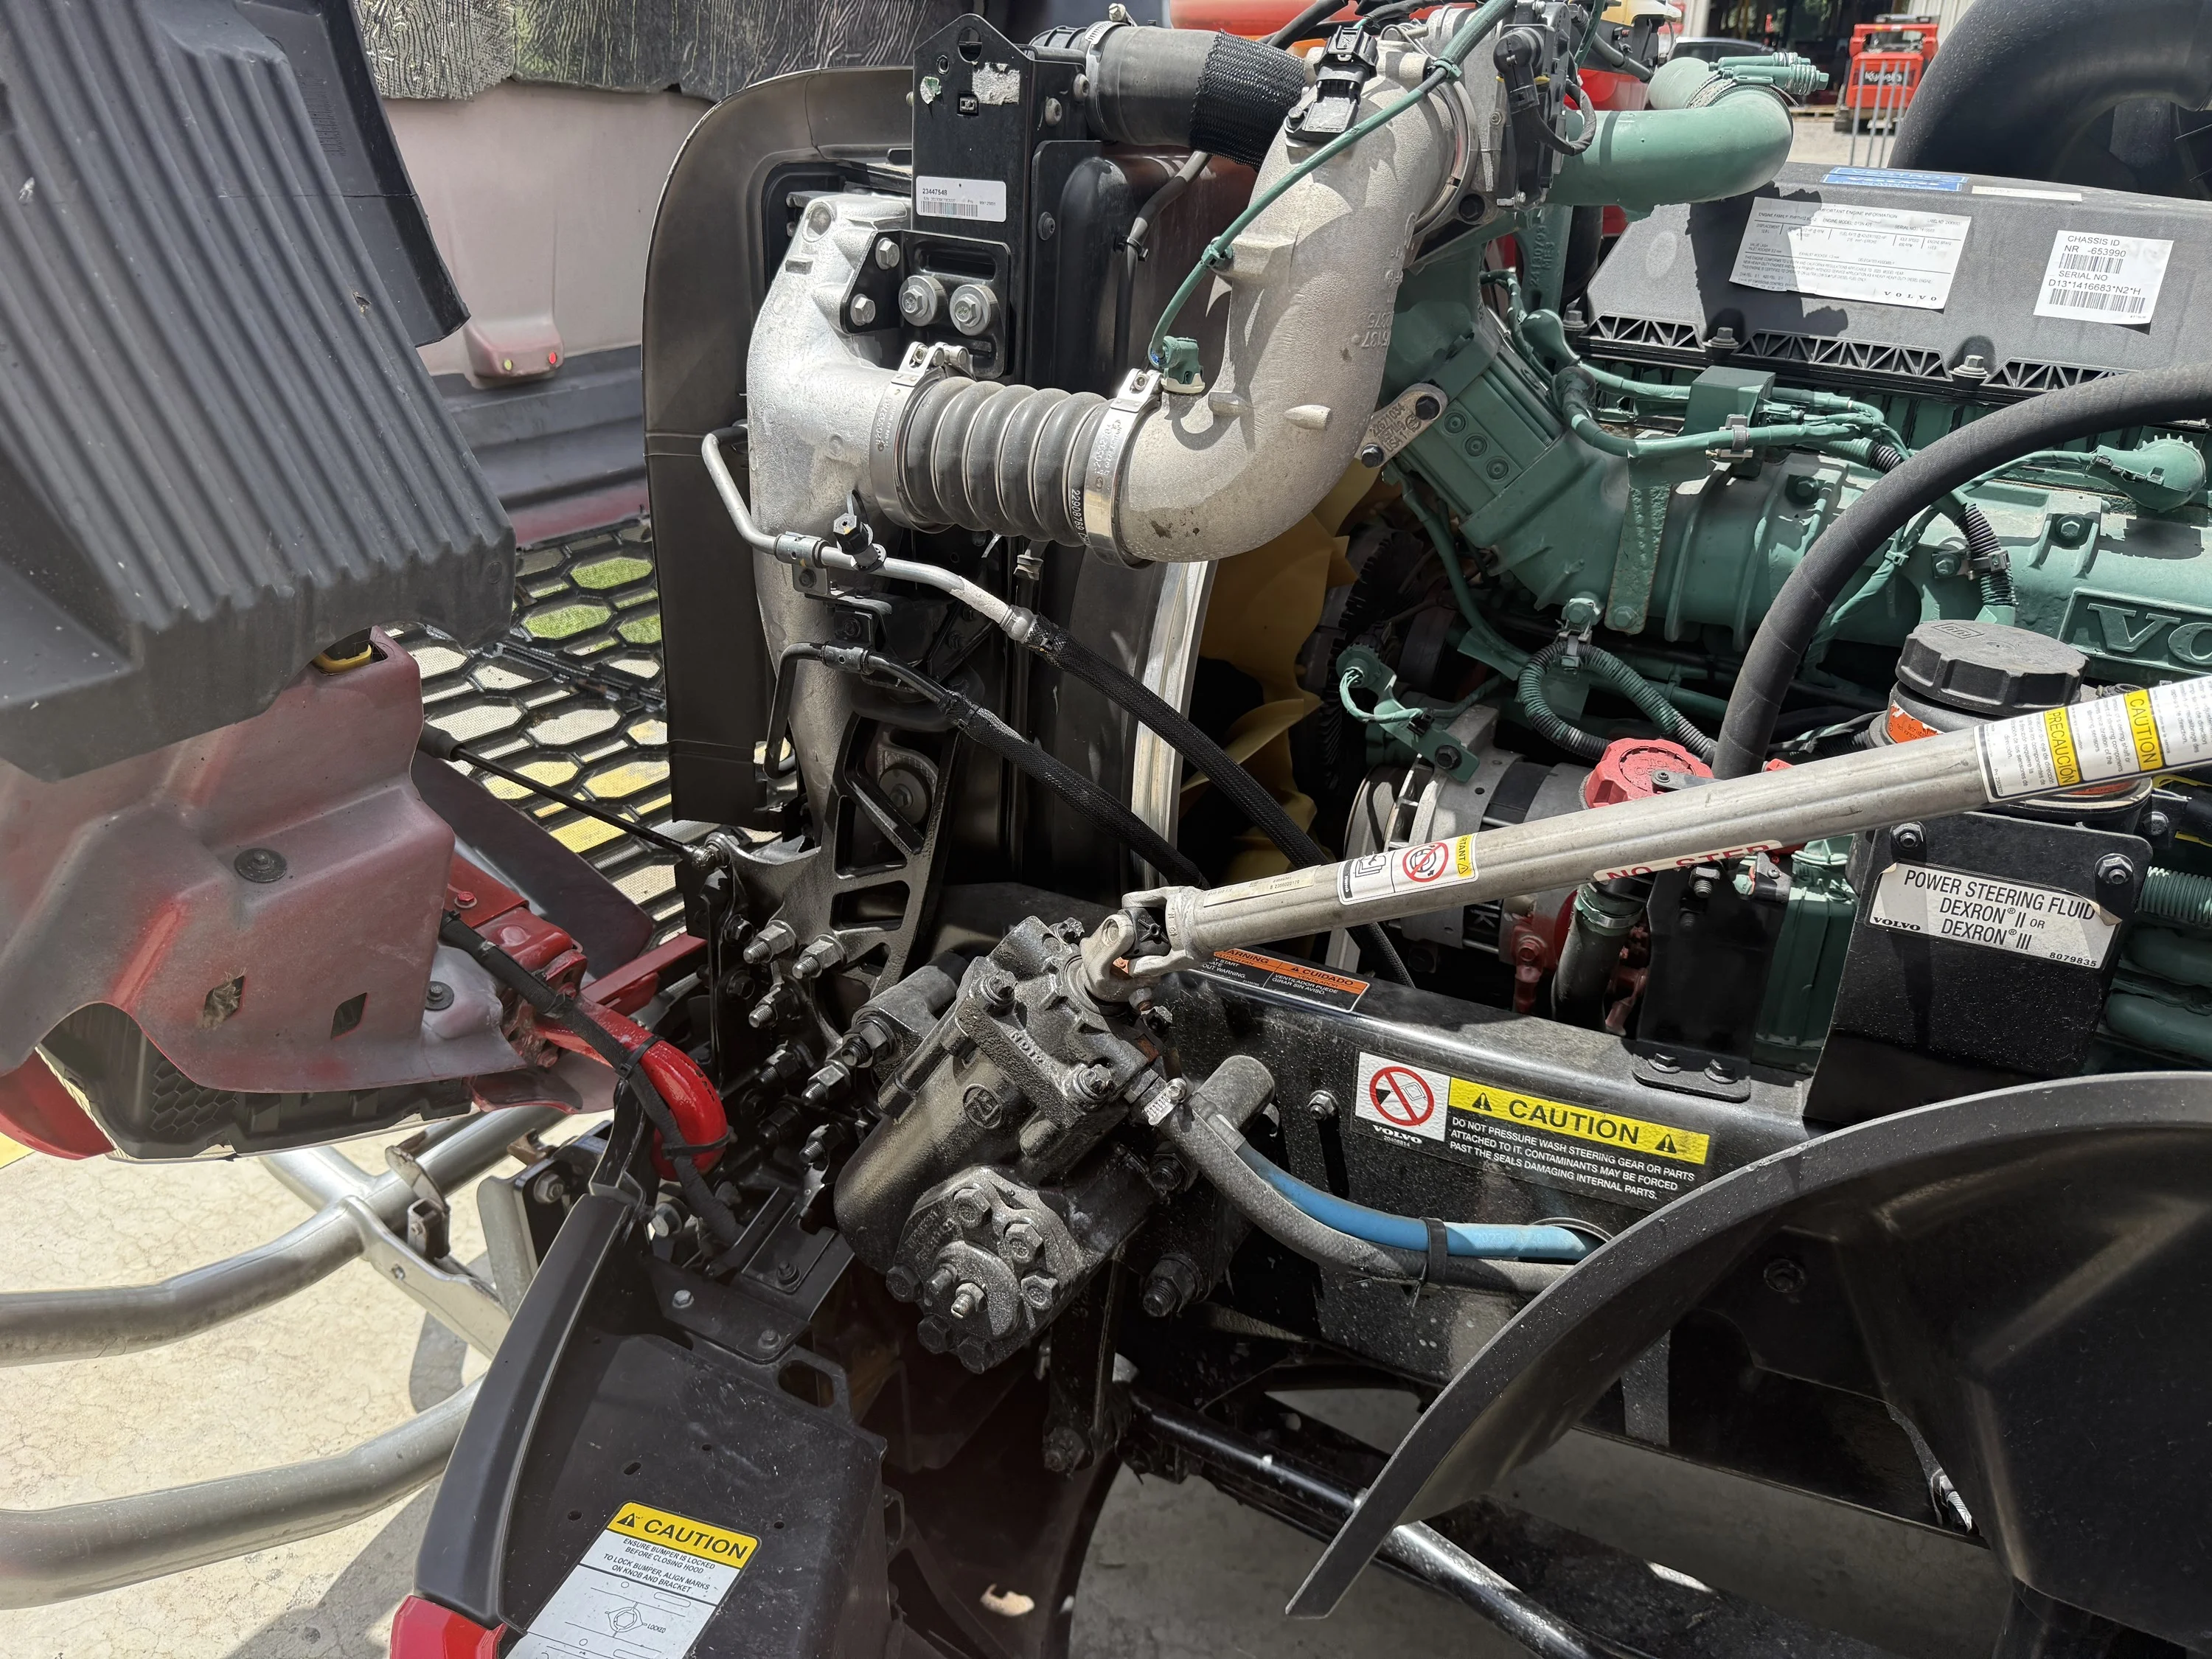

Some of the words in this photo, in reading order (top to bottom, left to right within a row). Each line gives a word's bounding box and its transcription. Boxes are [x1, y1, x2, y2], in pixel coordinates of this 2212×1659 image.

[2067, 235, 2108, 245] CHASSIS
[2065, 245, 2079, 253] NR
[2087, 247, 2126, 257] -653990
[2059, 271, 2091, 280] SERIAL
[1884, 291, 1937, 301] VOLVO
[1071, 488, 1085, 531] 22908769
[2130, 699, 2157, 763] CAUTION
[2048, 712, 2077, 784] PRECAUCIÓN
[1904, 869, 1962, 897] POWER
[1964, 881, 2045, 911] STEERING
[2048, 897, 2097, 921] FLUID
[1873, 916, 1921, 932] VOLVO
[2014, 911, 2025, 928] II
[2029, 919, 2045, 929] OR
[2017, 933, 2032, 950] III
[1220, 959, 1240, 967] START
[2049, 951, 2097, 967] 8079835
[1217, 966, 1246, 979] WARNING.
[1298, 974, 1339, 988] VENTILADOR
[1302, 969, 1354, 987] CUIDADO
[1272, 978, 1293, 987] GIRAR
[1304, 984, 1326, 995] AVISO.
[1275, 973, 1315, 988] VENTILADOR
[1314, 984, 1339, 994] PUEDE
[1508, 1099, 1640, 1145] CAUTION
[1373, 1124, 1422, 1144] VOLVO
[1453, 1117, 1465, 1127] DO
[1467, 1121, 1486, 1133] NOT
[1489, 1127, 1537, 1146] PRESSURE
[1540, 1138, 1566, 1152] WASH
[1568, 1146, 1615, 1164] STEERING
[1618, 1158, 1644, 1171] GEAR
[1646, 1164, 1660, 1174] OR
[1663, 1167, 1695, 1181] PARTS
[1450, 1141, 1472, 1154] PAST
[1474, 1147, 1491, 1159] THE
[1493, 1153, 1523, 1167] SEALS
[1524, 1161, 1575, 1180] DAMAGING
[1576, 1174, 1622, 1192] INTERNAL
[1624, 1185, 1657, 1199] PARTS.
[1451, 1130, 1497, 1147] ATTACHED
[1499, 1141, 1511, 1152] TO
[1513, 1146, 1523, 1155] IT.
[1525, 1148, 1599, 1172] CONTAMINANTS
[1600, 1166, 1621, 1178] MAY
[1623, 1171, 1636, 1181] BE
[1638, 1175, 1677, 1190] FORCED
[644, 1519, 748, 1559] CAUTION
[623, 1538, 650, 1551] ENSURE
[652, 1546, 679, 1559] BUMPER
[687, 1557, 715, 1569] LOCKED
[625, 1547, 653, 1559] BEFORE
[653, 1554, 683, 1568] CLOSING
[684, 1564, 703, 1573] HOOD
[603, 1553, 613, 1561] TO
[613, 1556, 632, 1566] LOCK
[633, 1562, 662, 1576] BUMPER,
[663, 1572, 684, 1582] ALIGN
[686, 1578, 710, 1590] MARKS
[622, 1568, 642, 1578] KNOB
[643, 1574, 658, 1583] AND
[659, 1579, 692, 1593] BRACKET
[647, 1623, 667, 1634] LOCKED
